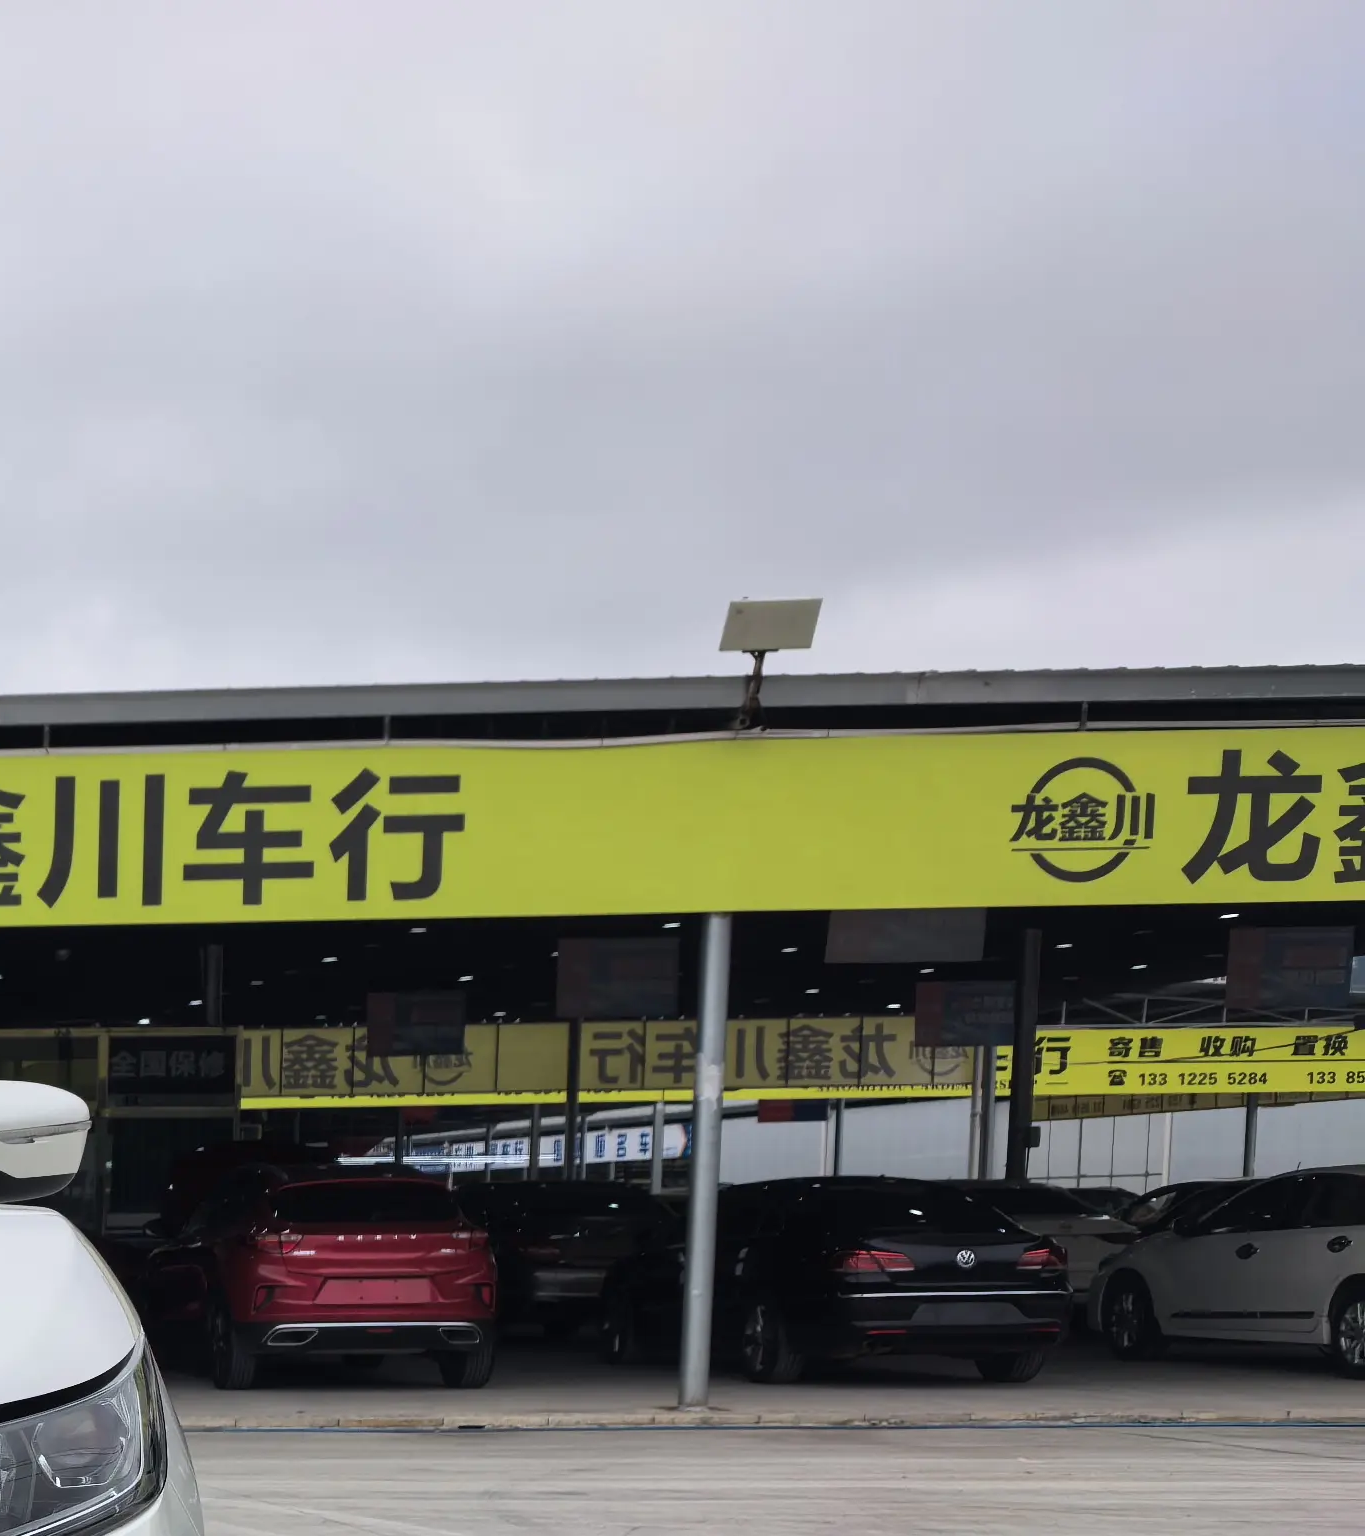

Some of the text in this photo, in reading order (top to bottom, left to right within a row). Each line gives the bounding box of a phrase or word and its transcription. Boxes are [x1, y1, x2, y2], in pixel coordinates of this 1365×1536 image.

[1009, 791, 1156, 842] 龙鑫川
[1181, 749, 1365, 884] 龙
[1108, 1034, 1349, 1058] 寄售 收购 置换
[1138, 1072, 1168, 1086] 133
[1178, 1072, 1218, 1086] 1225
[1227, 1072, 1267, 1085] 5284
[1307, 1071, 1337, 1085] 133
